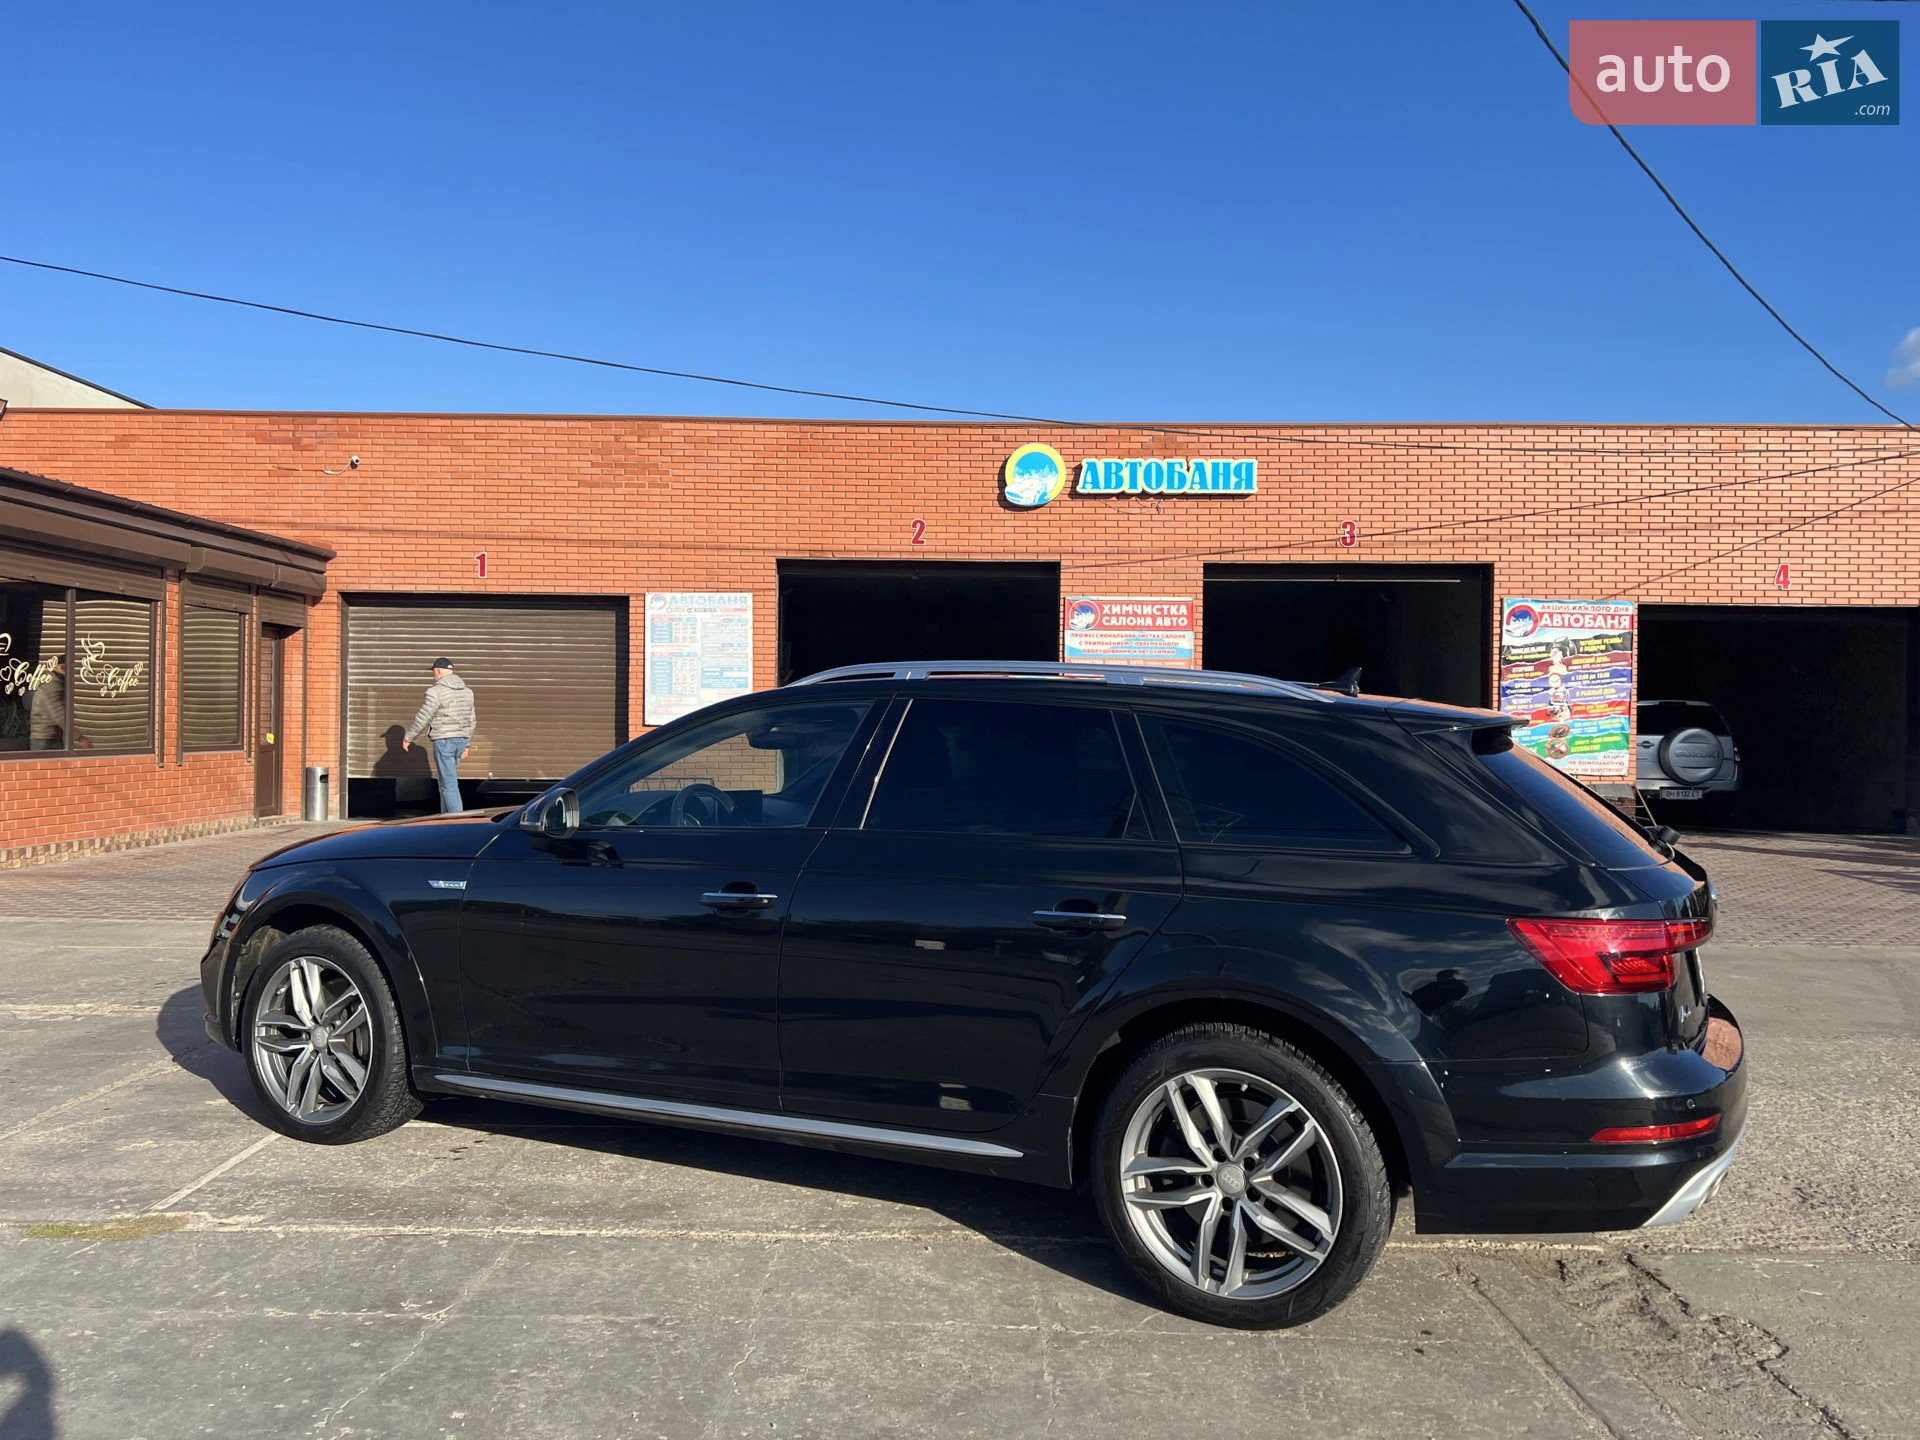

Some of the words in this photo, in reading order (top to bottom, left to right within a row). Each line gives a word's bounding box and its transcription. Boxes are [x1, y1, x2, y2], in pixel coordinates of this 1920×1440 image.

[1080, 459, 1257, 491] АВТОБАНЯ
[911, 518, 926, 545] 2
[1340, 520, 1357, 547] 3
[475, 552, 487, 579] 1
[1774, 564, 1792, 590] 4
[668, 595, 748, 606] АВТОБАНЯ
[1102, 604, 1188, 616] ХИМЧИСТКА
[1572, 605, 1612, 613] КАЖДОГО
[1102, 616, 1153, 627] САЛОНА
[1155, 617, 1188, 627] АВТО
[1539, 613, 1630, 629] АВТОБАНЯ
[9, 658, 53, 691] Coffee
[103, 664, 139, 694] Coffee
